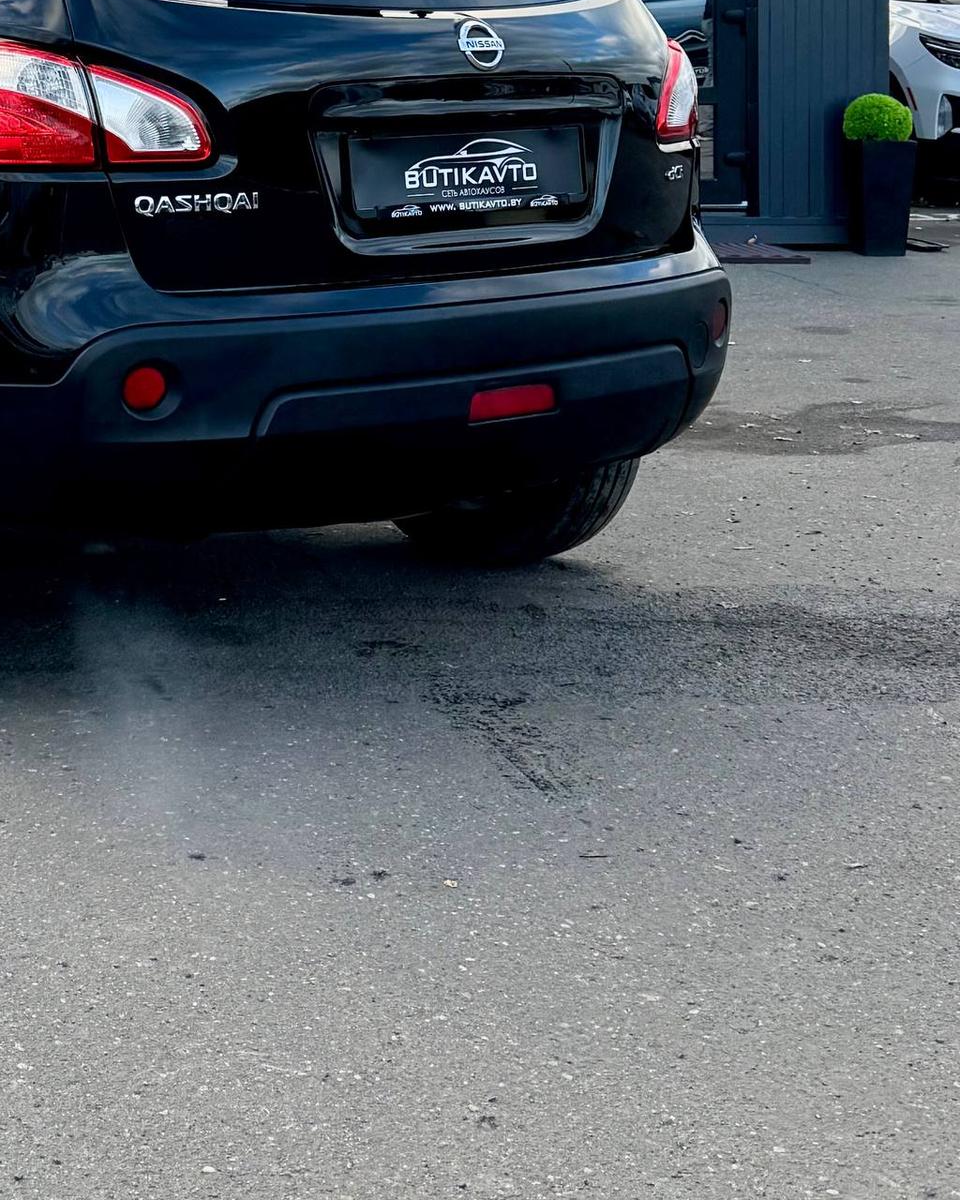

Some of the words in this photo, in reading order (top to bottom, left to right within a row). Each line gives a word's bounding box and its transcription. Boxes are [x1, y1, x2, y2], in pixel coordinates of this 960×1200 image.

[466, 40, 502, 48] NISSAN
[405, 163, 538, 189] BUTIKAVTO
[441, 189, 458, 198] СЕТЬ
[459, 186, 505, 196] АВТОХАУСОВ
[134, 191, 259, 216] QASHQAI
